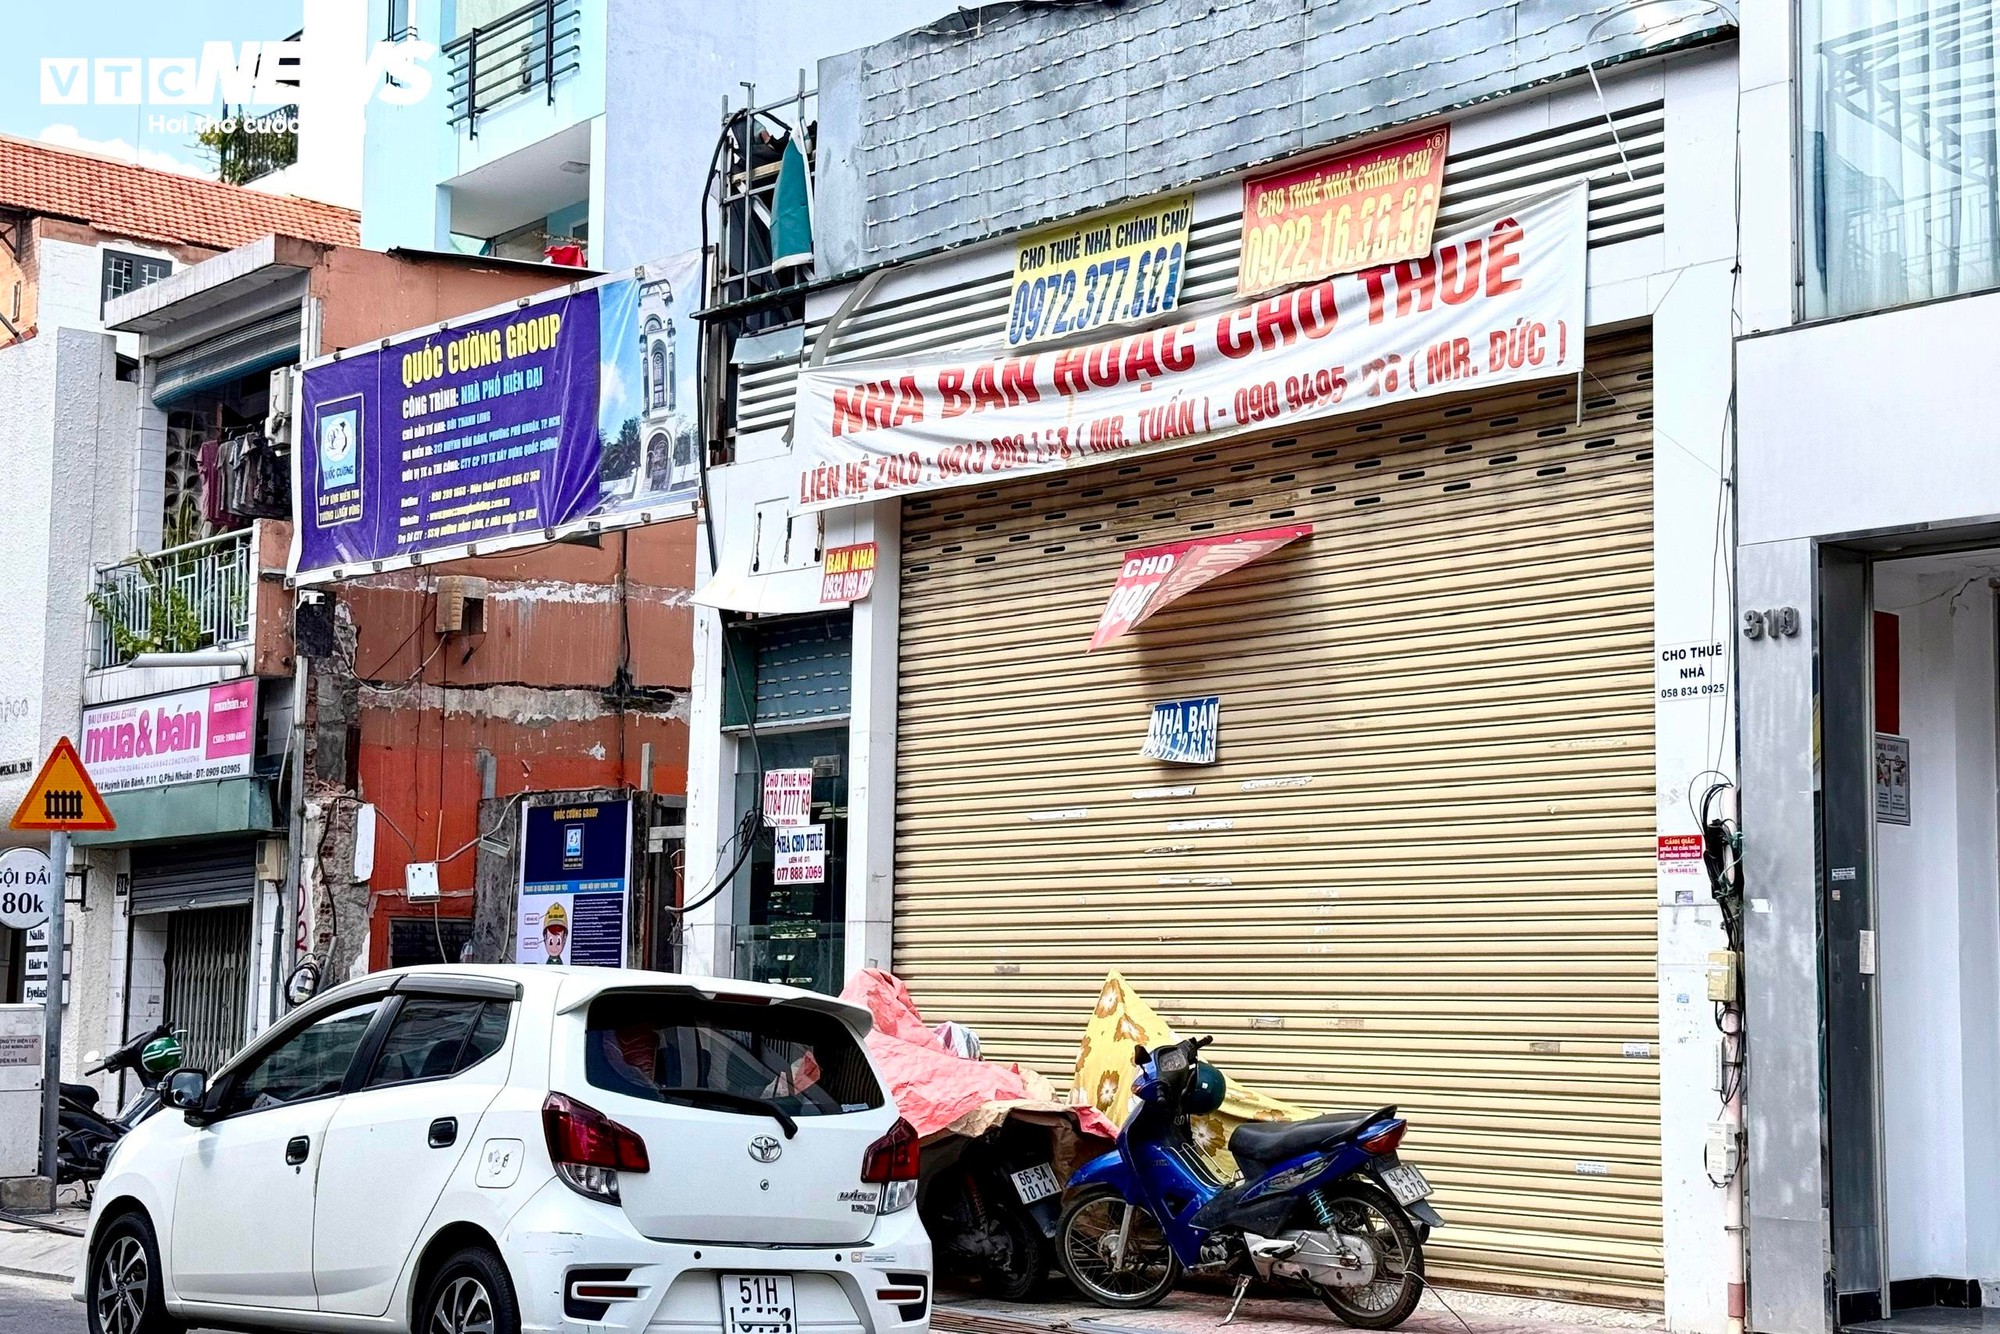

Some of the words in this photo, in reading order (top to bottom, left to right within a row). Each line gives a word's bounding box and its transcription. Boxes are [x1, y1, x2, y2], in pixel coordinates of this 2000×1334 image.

[1257, 187, 1284, 218] CHO
[1289, 172, 1321, 211] THUÊ
[1323, 164, 1353, 200] NHÀ
[1355, 155, 1400, 193] CHÍNH
[1402, 139, 1433, 180] CHỦ
[1020, 245, 1045, 272] CHO
[1050, 231, 1081, 265] THUÊ
[1085, 223, 1111, 256] NHÀ
[1116, 215, 1157, 248] CHÍNH
[1161, 200, 1189, 237] CHỦ
[1216, 278, 1339, 361] CHO
[1356, 217, 1524, 326] THUÊ
[402, 337, 444, 388] QUỐC
[448, 329, 503, 374] CƯỜNG
[506, 313, 561, 359] GROUP
[402, 395, 428, 420] CÔNG
[429, 388, 460, 413] TRÌNH:
[461, 380, 480, 405] NHÀ
[482, 371, 500, 400] PHỐ
[503, 370, 524, 396] HIỆN
[526, 366, 543, 391] ĐẠI
[800, 461, 840, 504] LIÊN
[844, 453, 870, 500] HỆ
[873, 450, 923, 489] ZALO
[937, 441, 988, 478] 0913
[1089, 414, 1130, 454] MR.
[1138, 389, 1197, 442] TUẤN
[1235, 380, 1280, 426] 090
[1426, 336, 1479, 385] MR.
[1489, 317, 1547, 374] ĐỨC
[826, 549, 850, 574] BÁN
[851, 544, 875, 571] NHÀ
[1122, 553, 1175, 579] CHO
[1743, 606, 1800, 640] 319
[1662, 648, 1687, 662] CHO
[1690, 641, 1722, 659] THUÊ
[1680, 664, 1705, 680] NHÀ
[1661, 688, 1678, 699] 058
[1681, 686, 1699, 697] 834
[1701, 683, 1725, 696] 0925
[155, 704, 201, 754] bán
[1149, 702, 1183, 736] NHÀ
[1188, 699, 1218, 732] BÁN
[104, 779, 120, 791] Huỳnh
[120, 778, 131, 788] Văn
[205, 765, 219, 777] 0909
[766, 773, 779, 788] CHO
[780, 770, 796, 788] THUÊ
[798, 769, 811, 787] NHÀ
[783, 789, 800, 815] 7777
[777, 830, 790, 853] NHÀ
[792, 834, 805, 852] CHO
[806, 828, 823, 852] THUÊ
[776, 867, 789, 880] 077
[790, 866, 803, 880] 888
[805, 865, 822, 879] 2069
[2, 892, 44, 914] 80k
[29, 929, 45, 940] Nails
[28, 959, 42, 969] Hair
[739, 1277, 778, 1304] 51H
